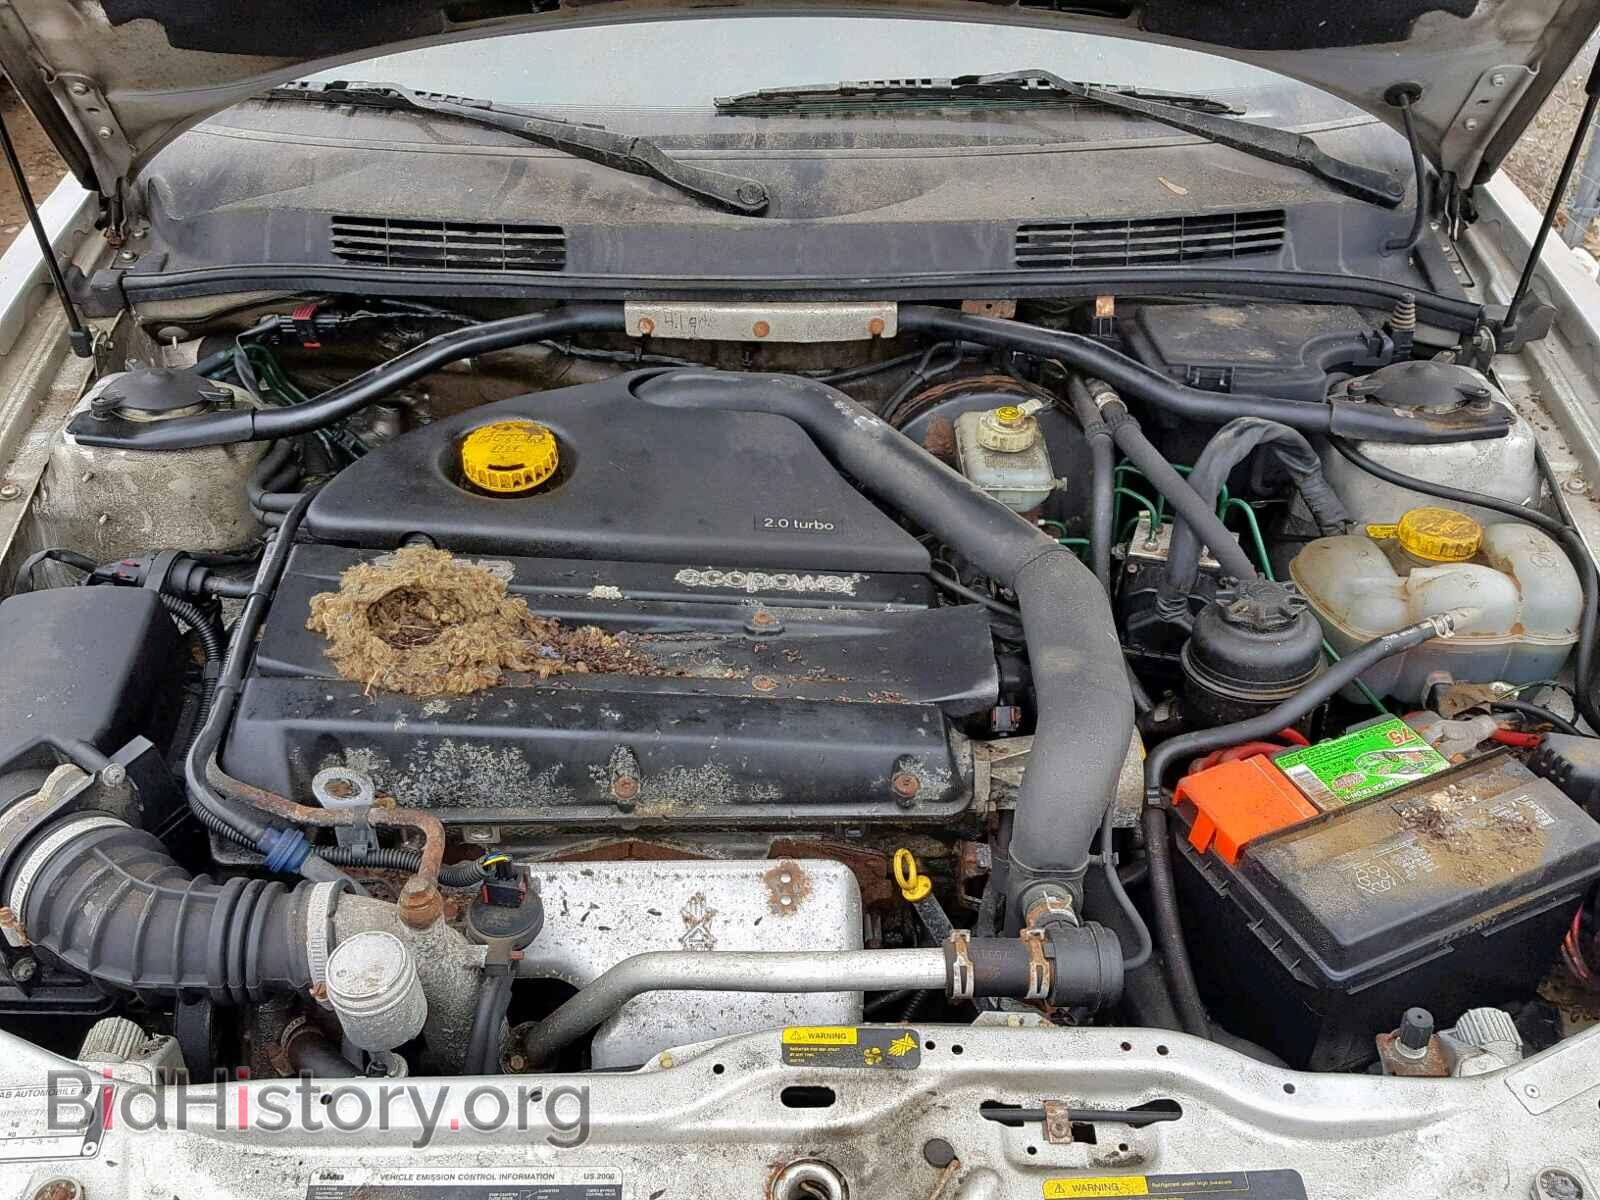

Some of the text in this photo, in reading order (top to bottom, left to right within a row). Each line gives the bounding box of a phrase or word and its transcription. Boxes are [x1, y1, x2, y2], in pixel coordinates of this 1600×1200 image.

[763, 518, 834, 530] 2.0 turbo
[1388, 727, 1417, 746] 75
[807, 1032, 847, 1040] WARNING
[1072, 1183, 1120, 1193] WARNING
